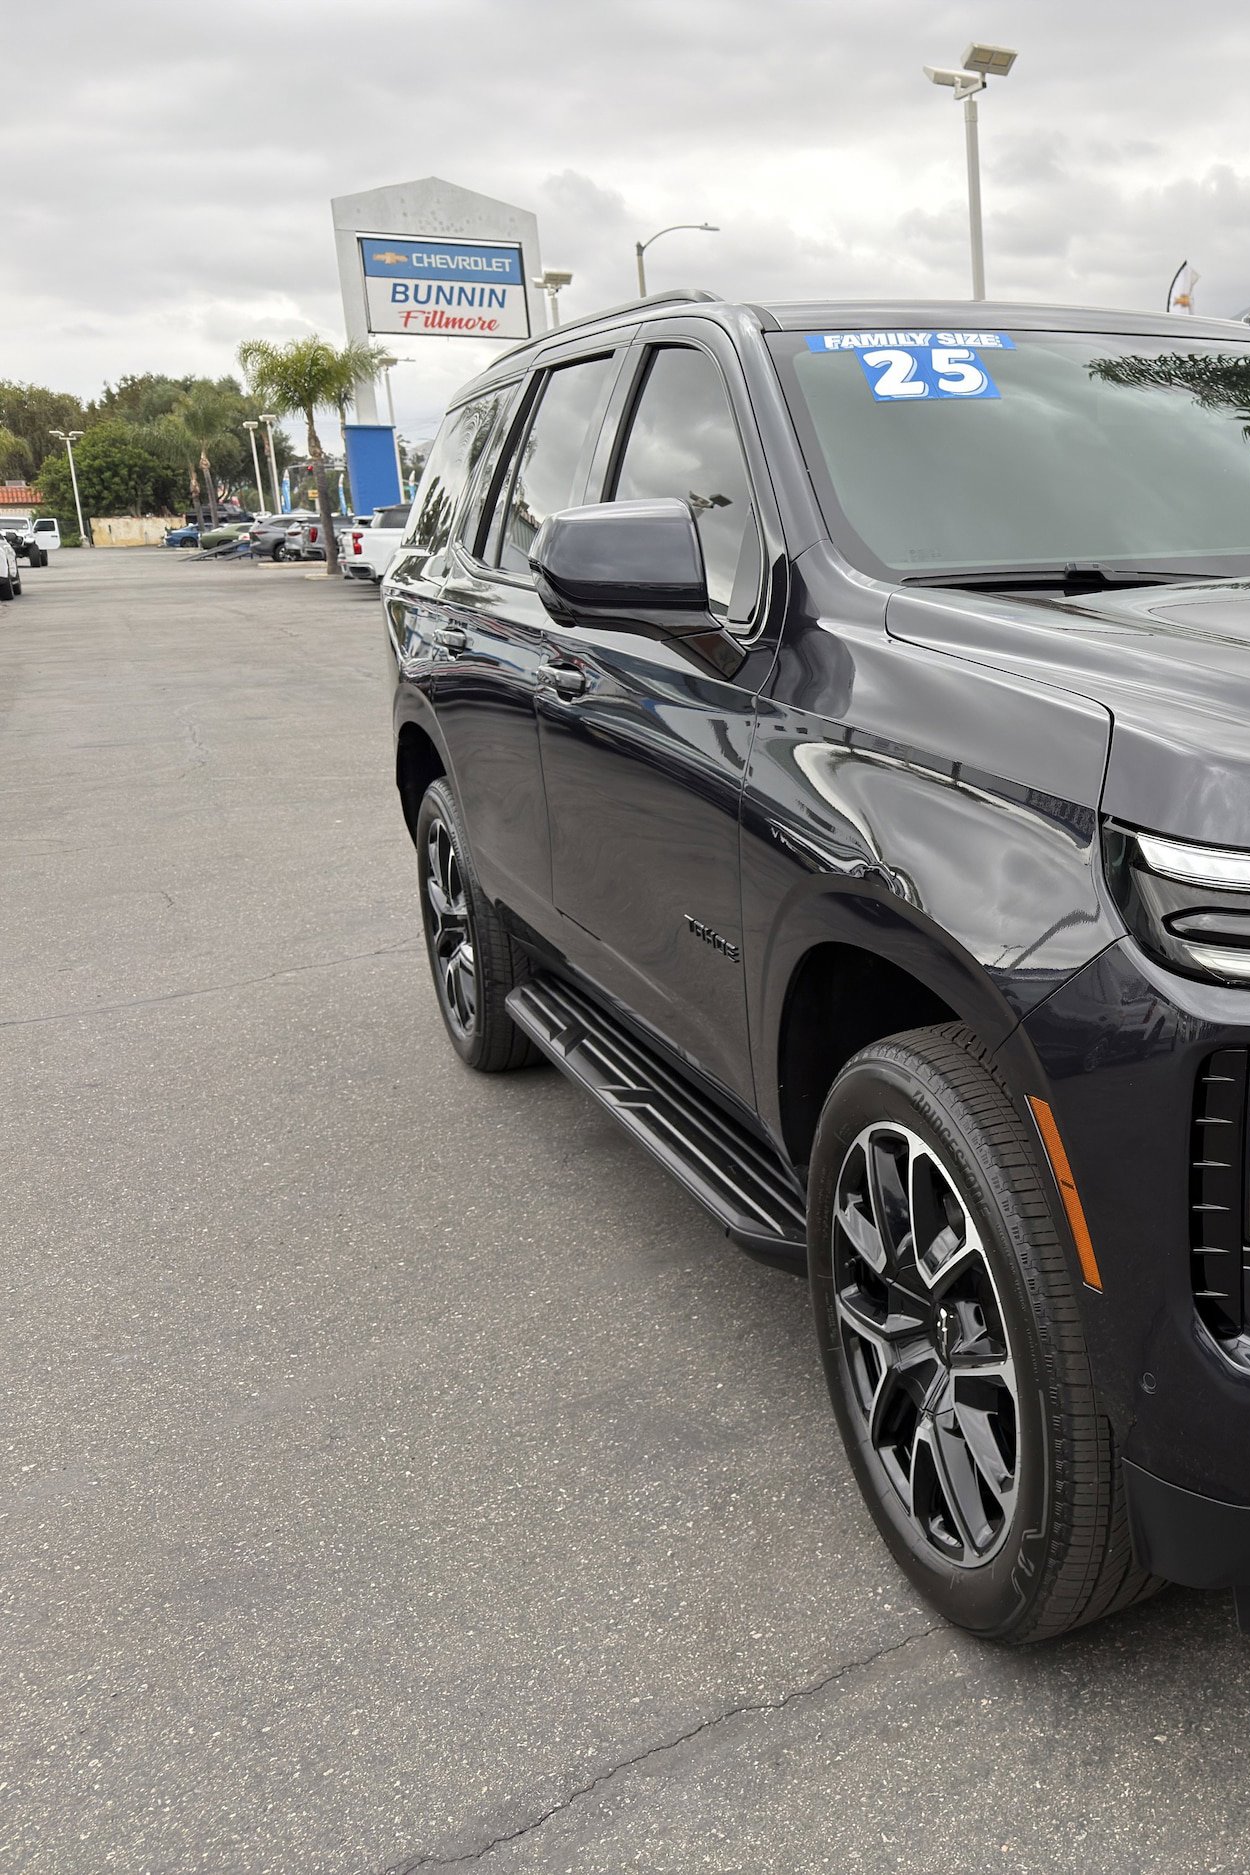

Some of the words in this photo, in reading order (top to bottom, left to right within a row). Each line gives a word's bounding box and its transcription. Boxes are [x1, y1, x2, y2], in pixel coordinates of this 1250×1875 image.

[412, 253, 512, 272] CHEVROLET
[391, 283, 507, 309] BUNNIN
[398, 310, 500, 331] Fillmore
[824, 332, 931, 349] FAMILY
[863, 349, 988, 398] 25
[684, 914, 740, 963] TAHOE
[912, 1090, 990, 1217] BRIDGESTONE
